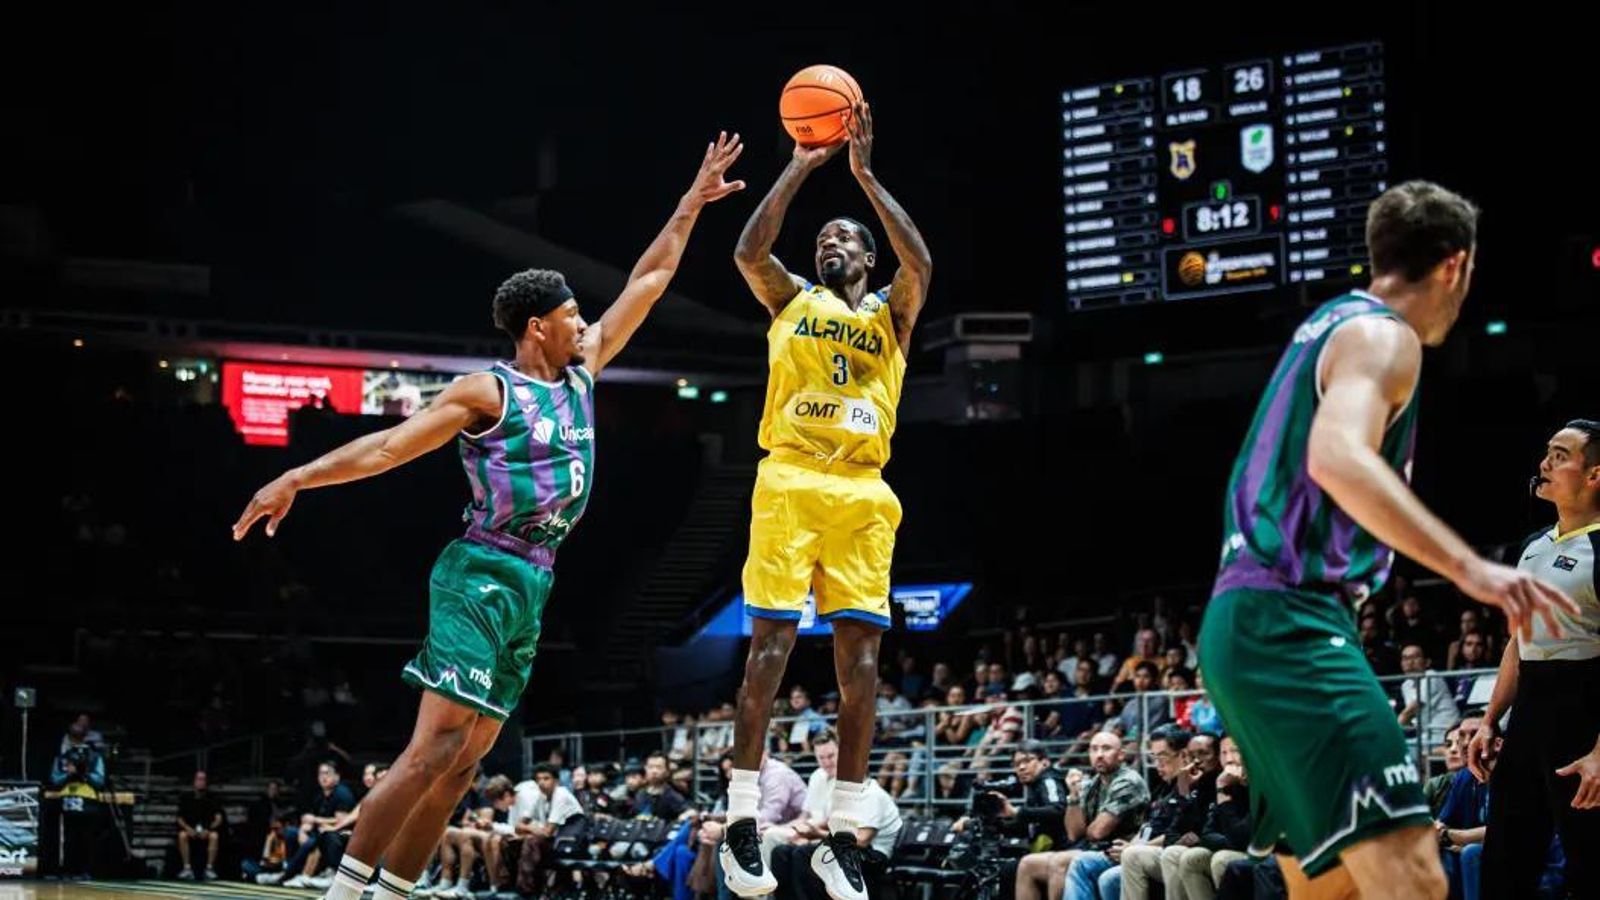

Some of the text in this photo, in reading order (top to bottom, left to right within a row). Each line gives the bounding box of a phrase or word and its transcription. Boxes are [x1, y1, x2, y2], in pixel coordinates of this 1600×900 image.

[1171, 76, 1202, 103] 18
[1233, 66, 1265, 94] 26
[1196, 201, 1250, 232] 8:12
[832, 353, 849, 386] 3
[795, 401, 840, 418] OMT
[569, 459, 586, 498] 6
